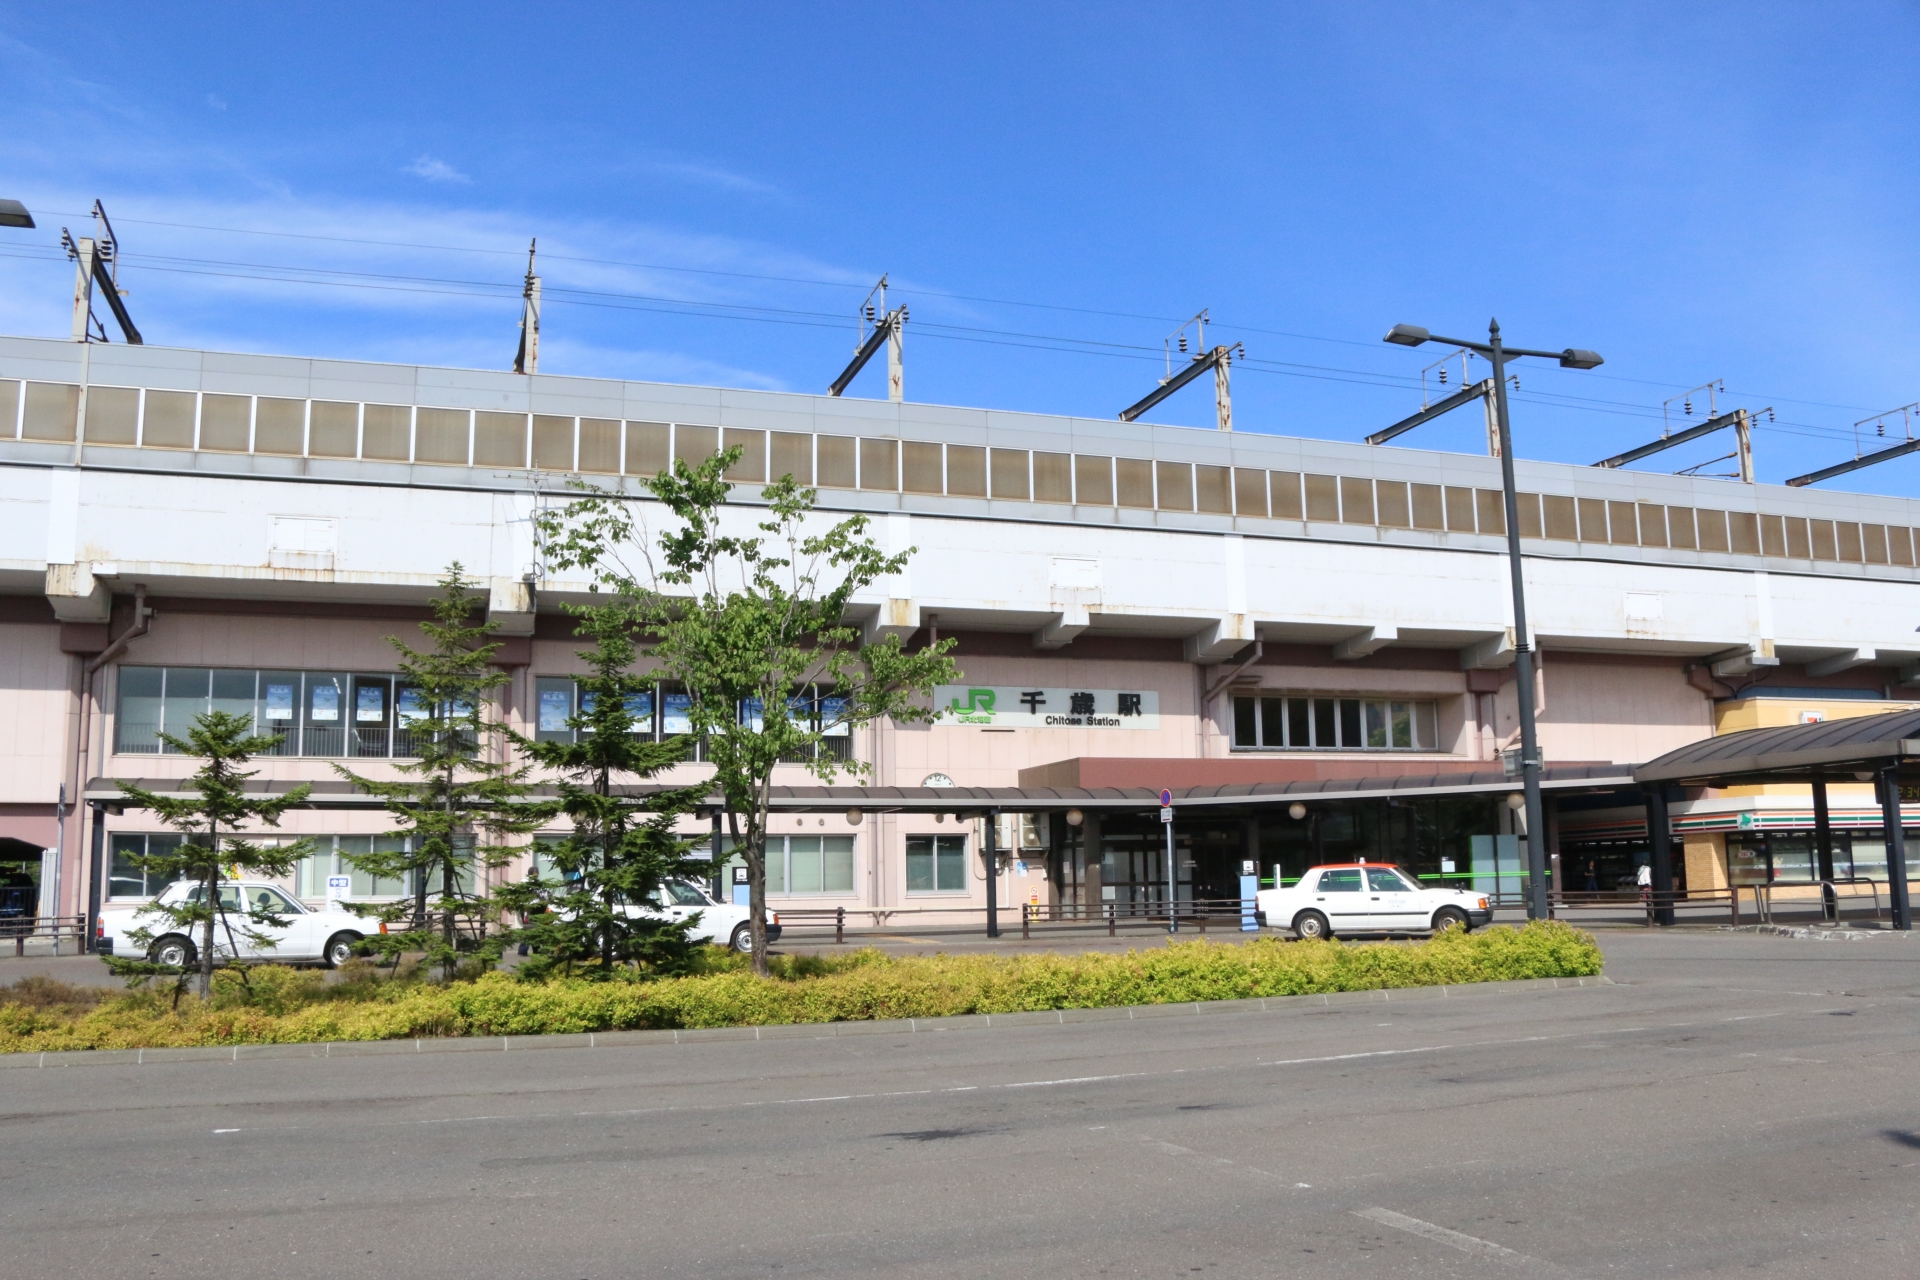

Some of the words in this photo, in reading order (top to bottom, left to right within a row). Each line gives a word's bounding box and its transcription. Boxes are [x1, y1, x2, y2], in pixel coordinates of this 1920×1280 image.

[952, 689, 996, 715] JR
[1020, 691, 1142, 717] 千歳駅
[1045, 715, 1082, 726] Chitose
[1086, 717, 1120, 726] Station
